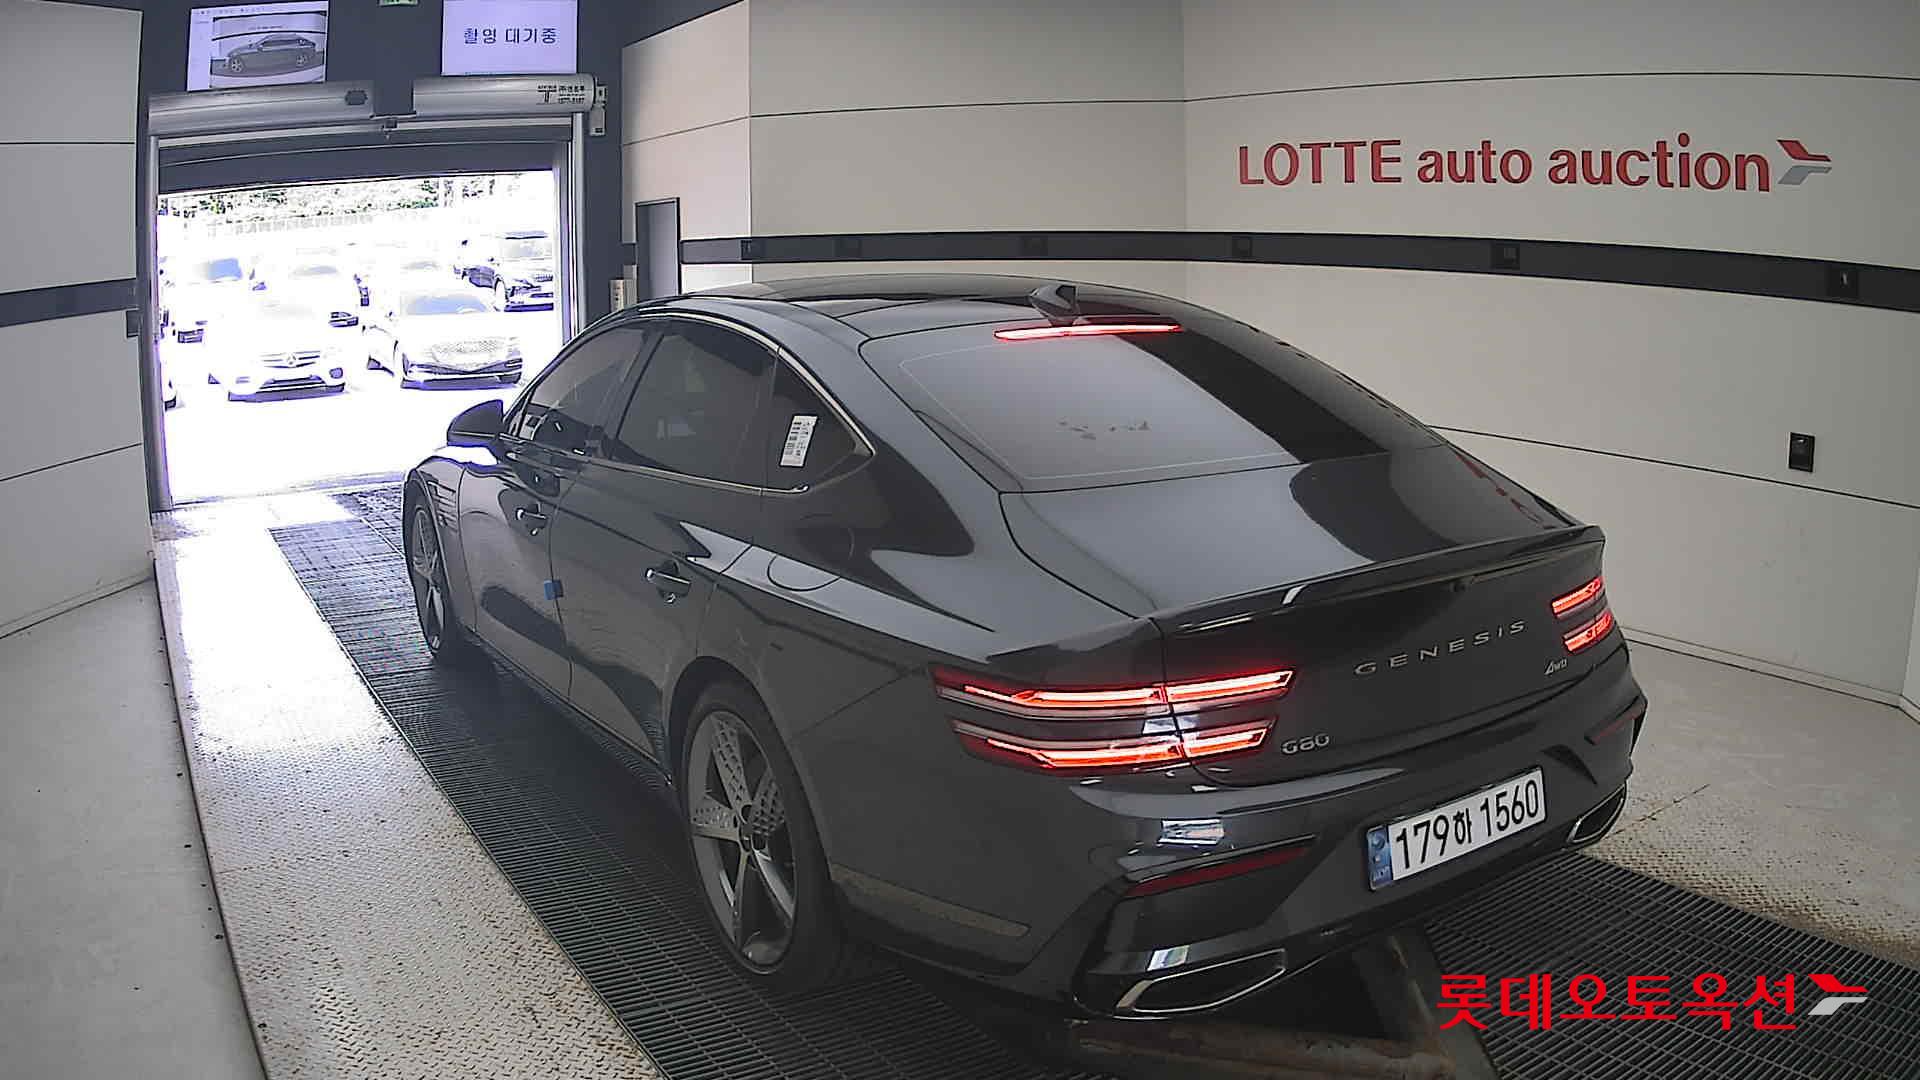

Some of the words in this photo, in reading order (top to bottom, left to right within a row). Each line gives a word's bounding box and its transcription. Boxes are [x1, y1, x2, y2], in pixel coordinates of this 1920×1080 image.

[504, 27, 557, 45] 대기중
[1239, 140, 1402, 186] LOTTE
[1417, 140, 1533, 185] auto
[1547, 132, 1771, 193] auction
[1354, 620, 1525, 675] GENESIS
[1396, 808, 1473, 869] 179하
[1480, 779, 1539, 837] 1560
